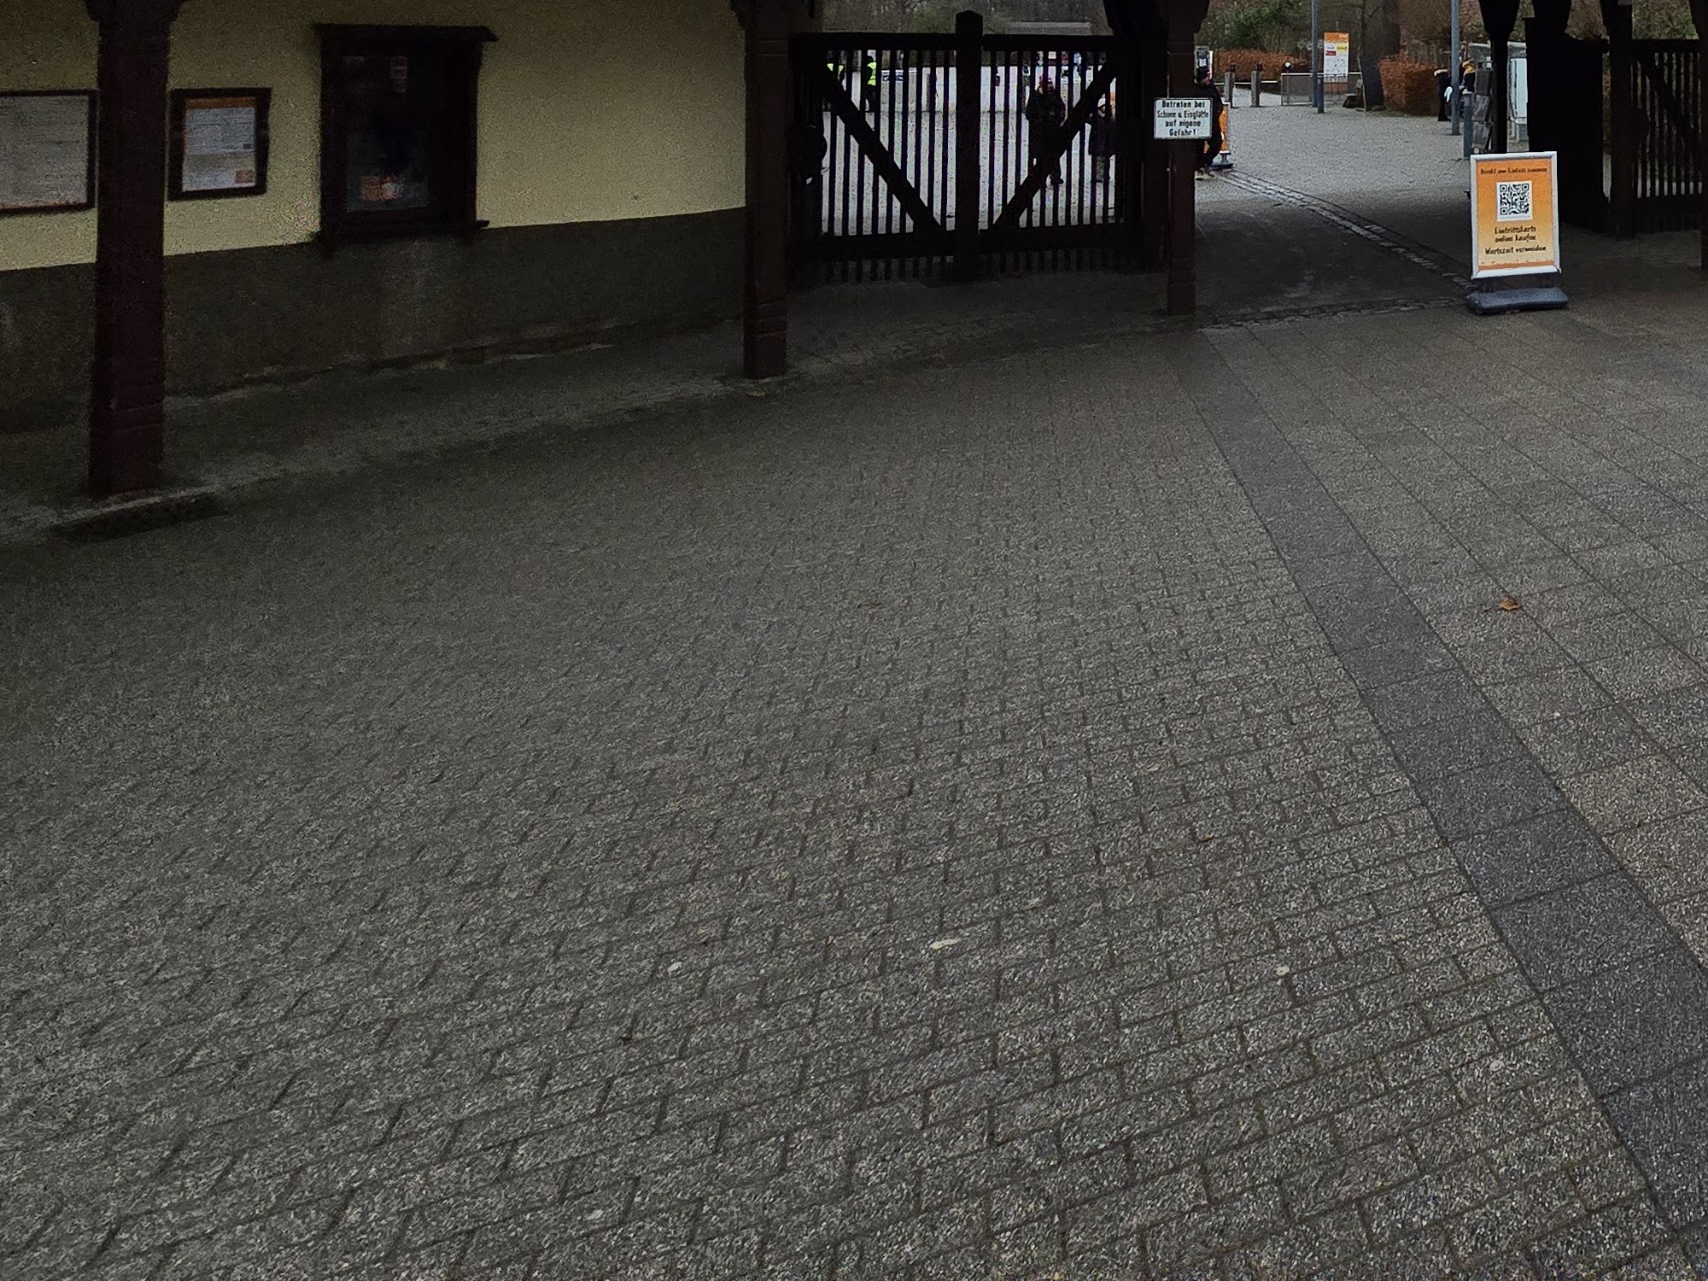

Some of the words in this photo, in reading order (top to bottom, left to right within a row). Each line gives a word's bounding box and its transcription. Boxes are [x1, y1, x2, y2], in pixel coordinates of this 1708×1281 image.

[1162, 100, 1191, 108] Betreten
[1194, 100, 1205, 108] bei
[1165, 119, 1176, 127] auf
[1179, 119, 1201, 128] eigene
